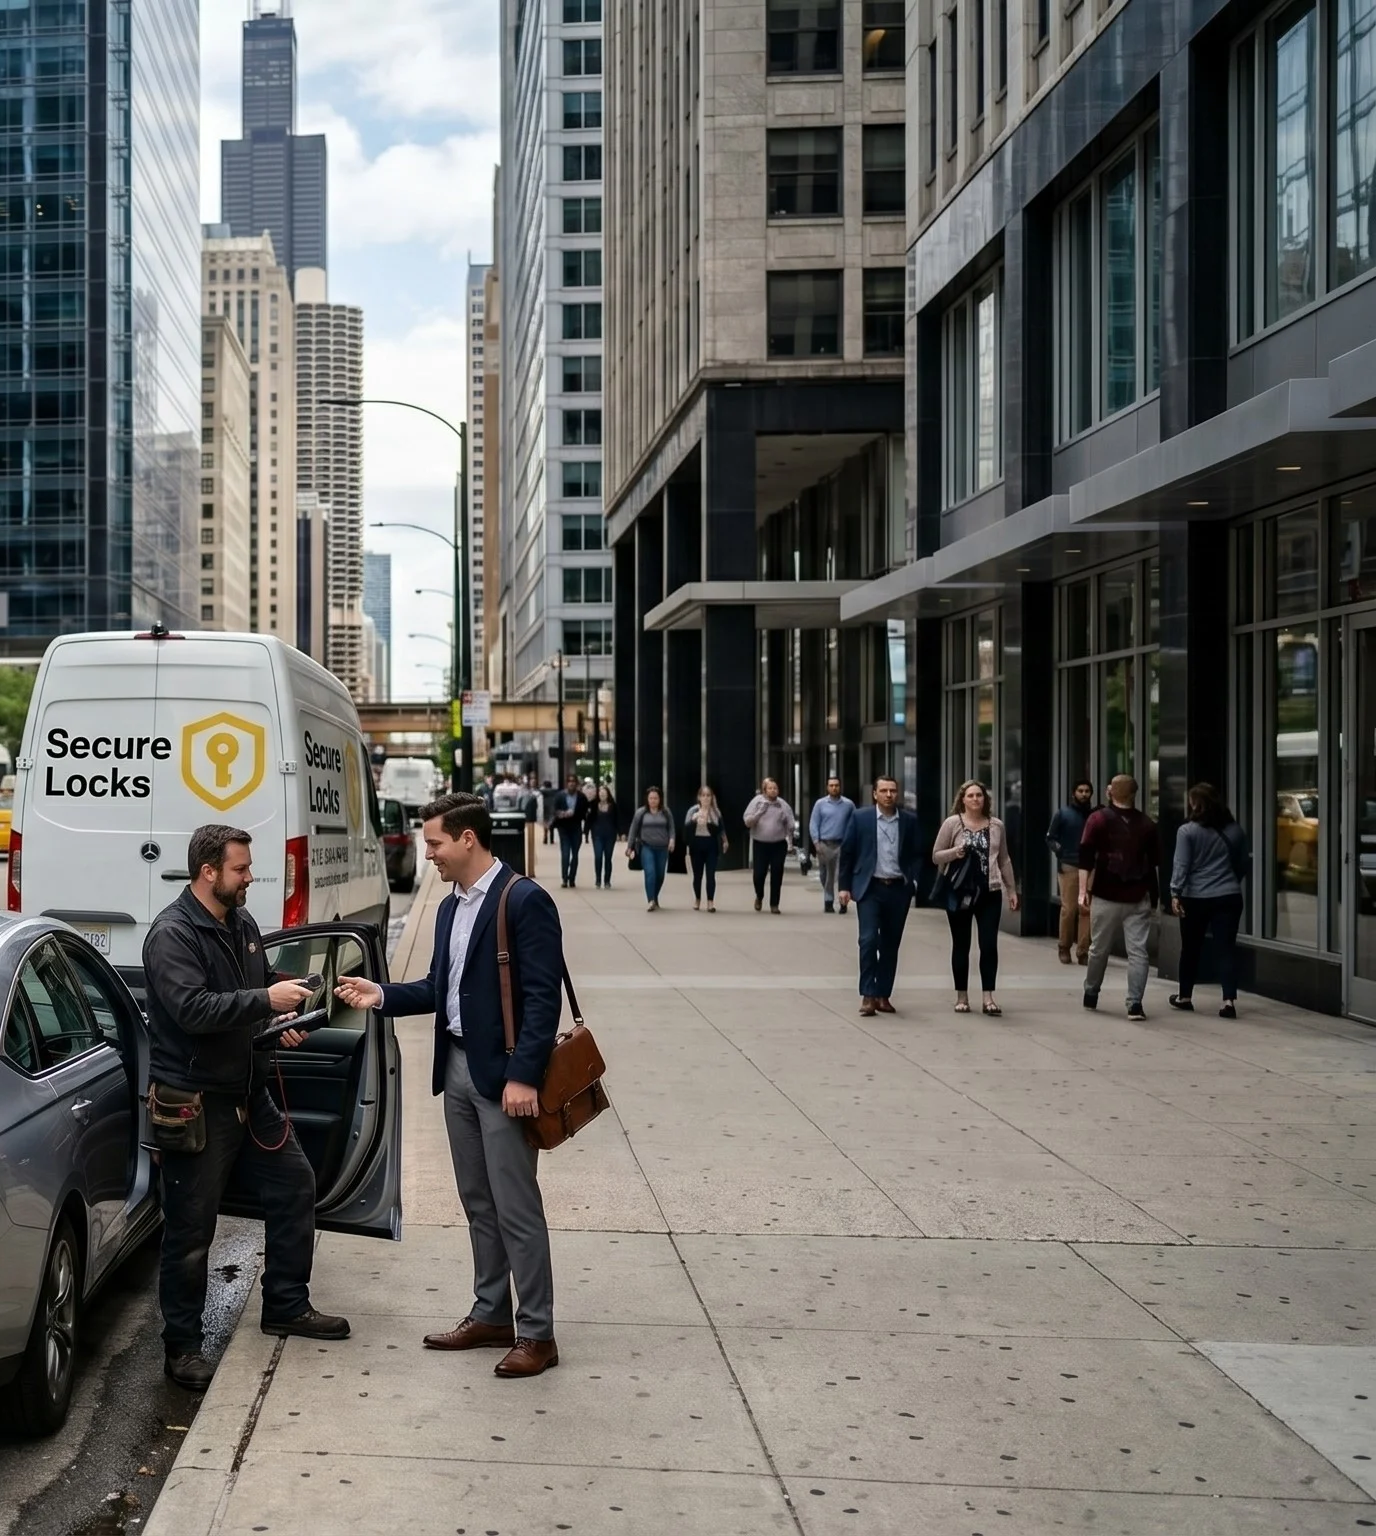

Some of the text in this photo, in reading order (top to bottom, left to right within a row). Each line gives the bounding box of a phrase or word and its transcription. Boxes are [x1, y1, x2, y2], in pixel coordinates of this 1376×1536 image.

[46, 728, 172, 760] Secure
[304, 730, 341, 773] Secure
[45, 766, 151, 798] Locks
[309, 775, 340, 815] Locks
